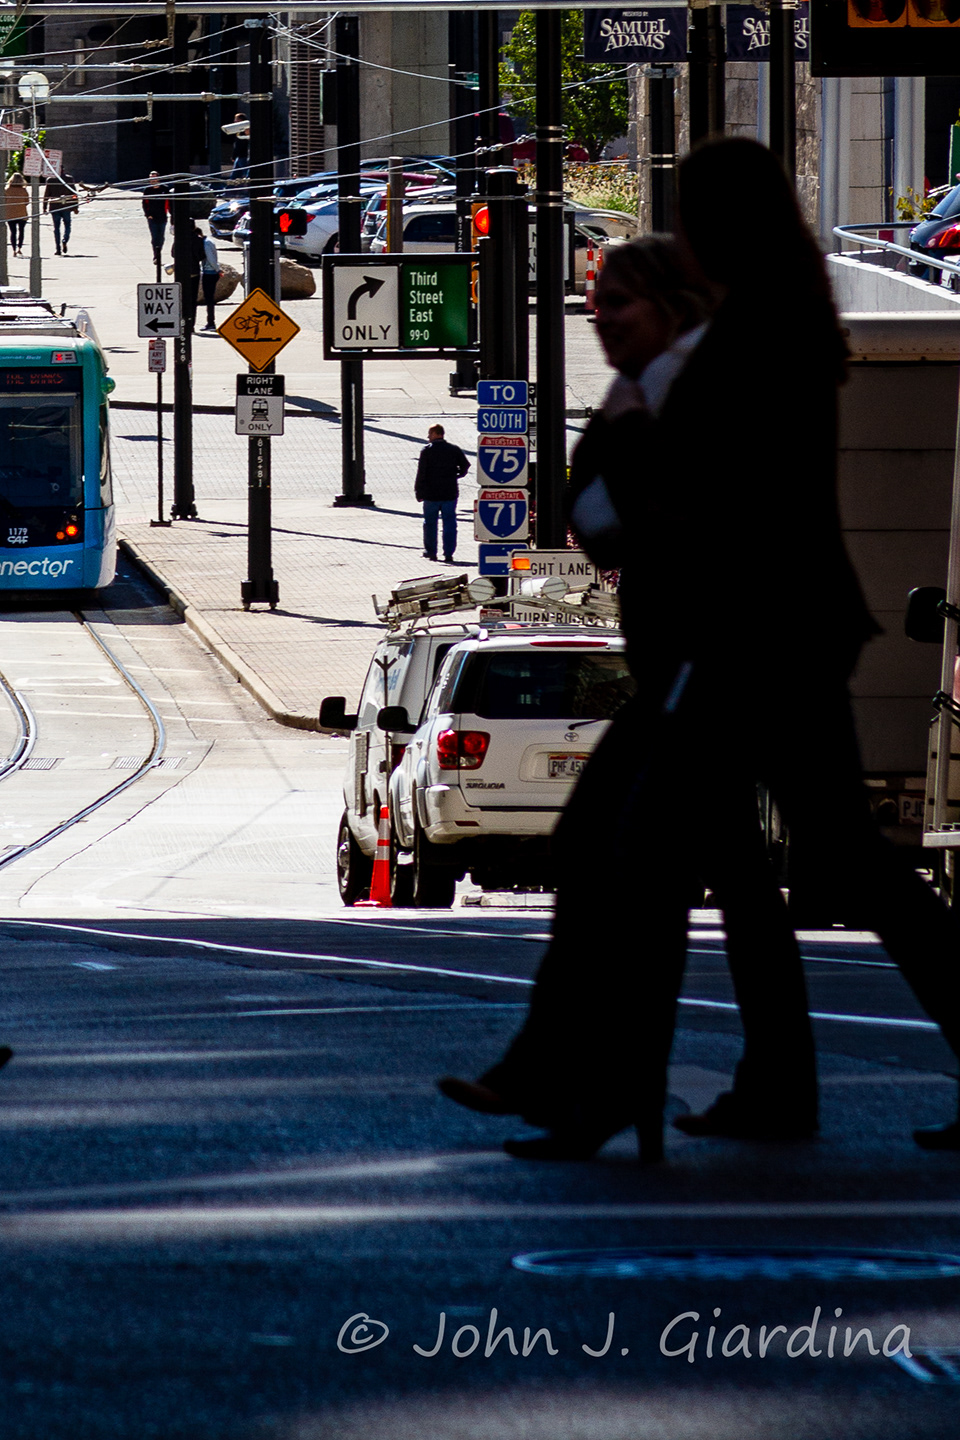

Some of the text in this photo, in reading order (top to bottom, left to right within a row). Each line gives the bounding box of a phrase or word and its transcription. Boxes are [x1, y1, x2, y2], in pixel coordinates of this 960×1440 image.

[600, 18, 671, 37] SAMUEL
[742, 17, 810, 36] SAEL
[604, 34, 665, 53] ADAMS
[747, 33, 809, 51] ADS
[410, 272, 438, 286] Third
[145, 289, 174, 300] ONE
[410, 290, 443, 304] Street
[144, 303, 174, 314] WAY
[410, 309, 433, 323] East
[342, 325, 391, 341] ONLY
[410, 329, 430, 341] 99-0
[246, 377, 274, 385] RIGHT
[247, 387, 273, 395] LANE
[490, 385, 515, 401] TO
[482, 413, 522, 429] SOUTH
[484, 449, 519, 473] 75
[488, 503, 517, 526] 71
[530, 563, 592, 576] GHT LANE
